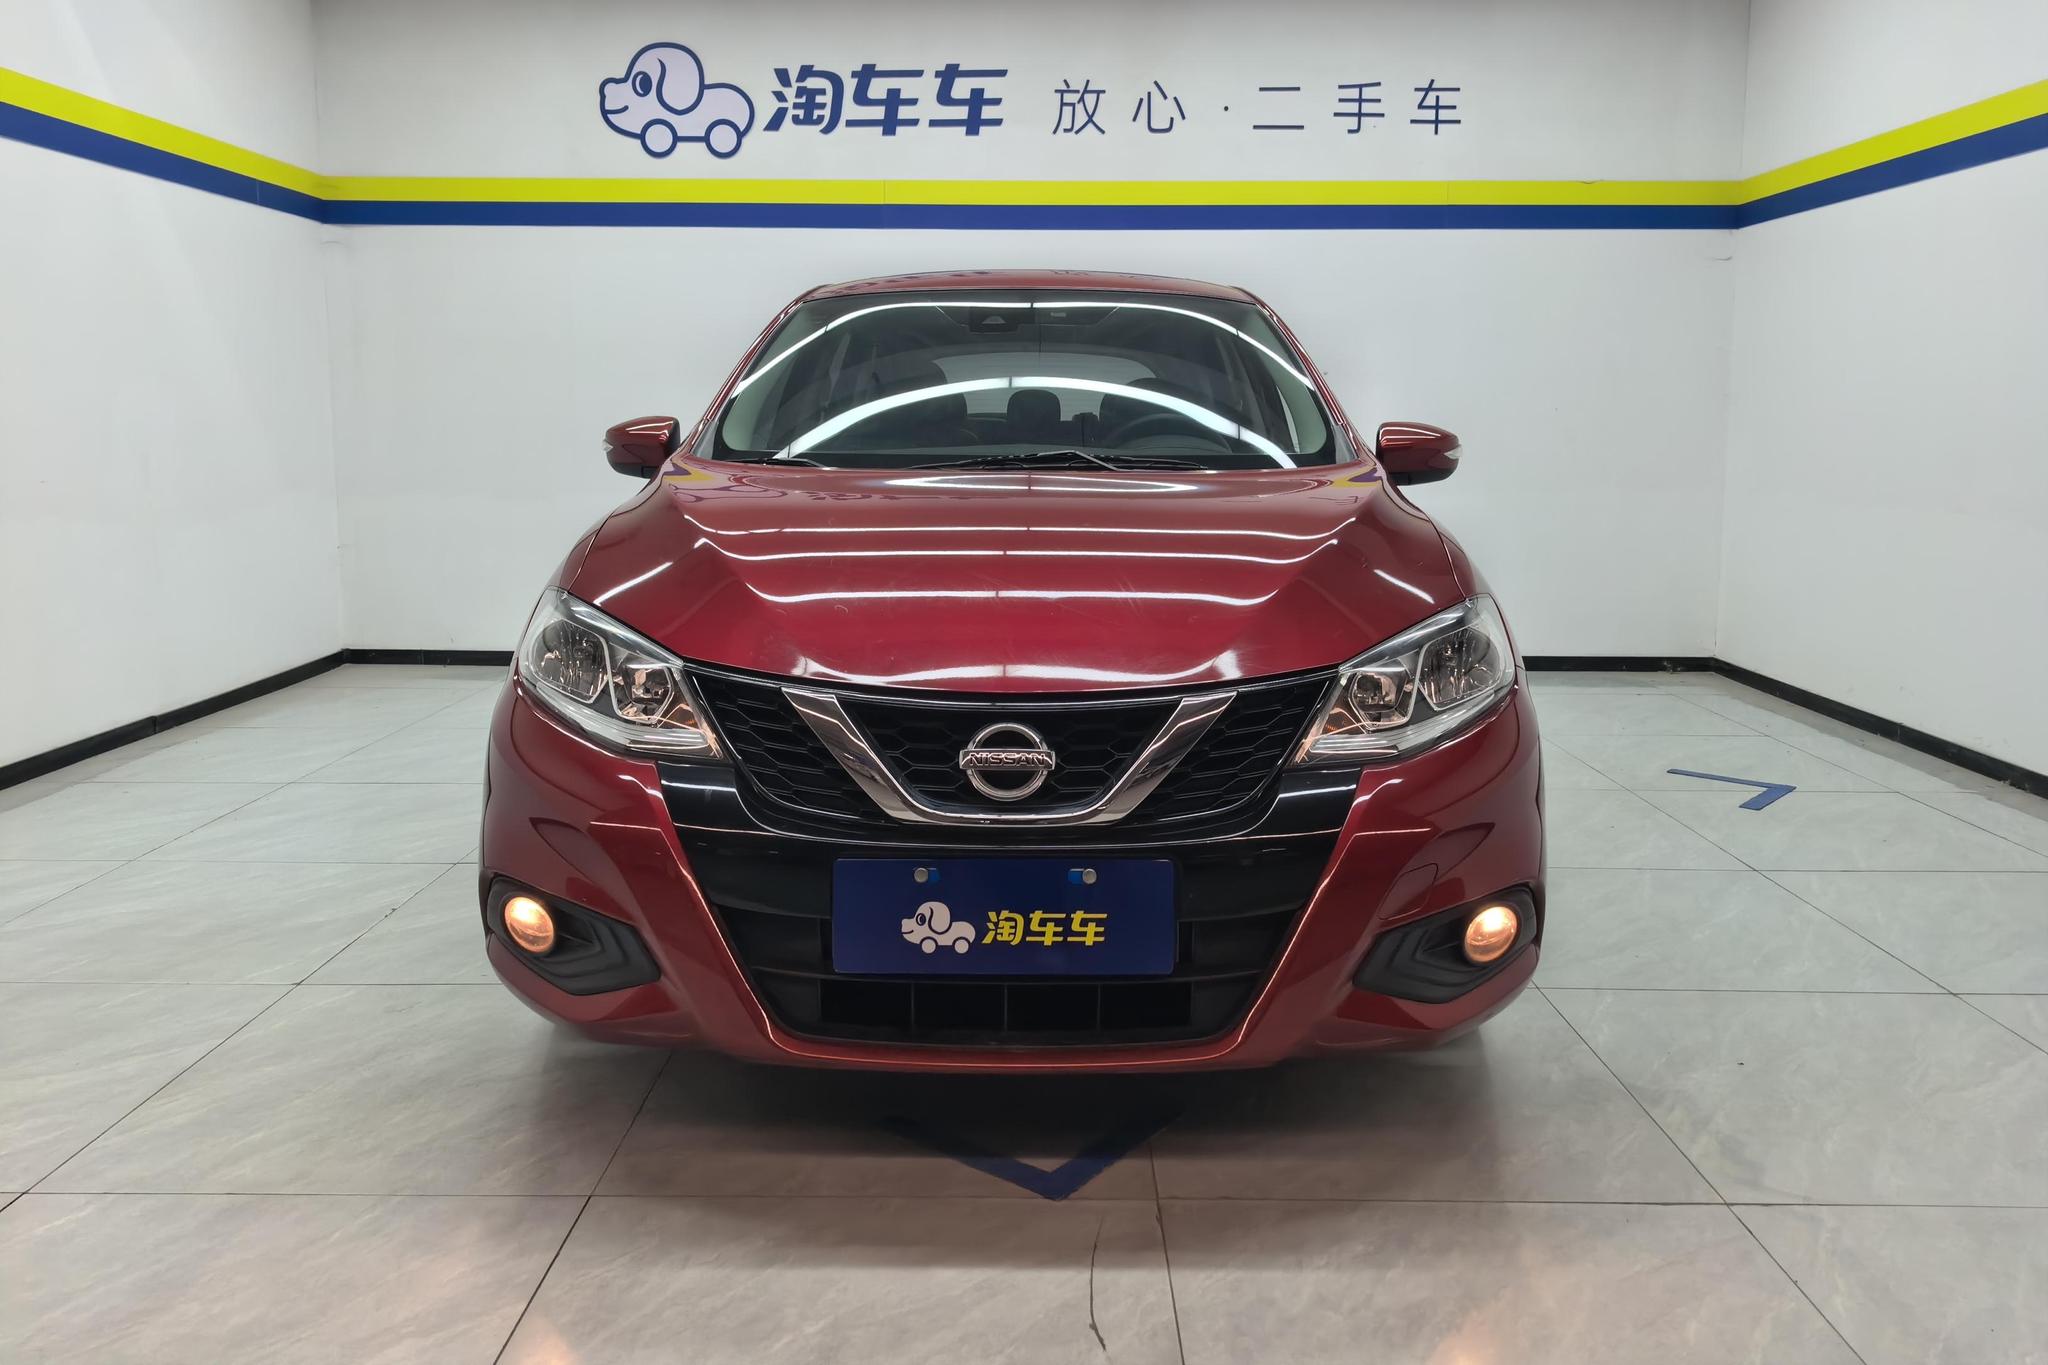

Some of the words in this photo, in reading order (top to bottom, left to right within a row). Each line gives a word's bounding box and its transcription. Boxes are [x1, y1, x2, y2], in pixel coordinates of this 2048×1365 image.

[763, 63, 1009, 136] 淘车车
[968, 752, 1047, 767] NISSAN
[981, 910, 1108, 947] 淘车车
